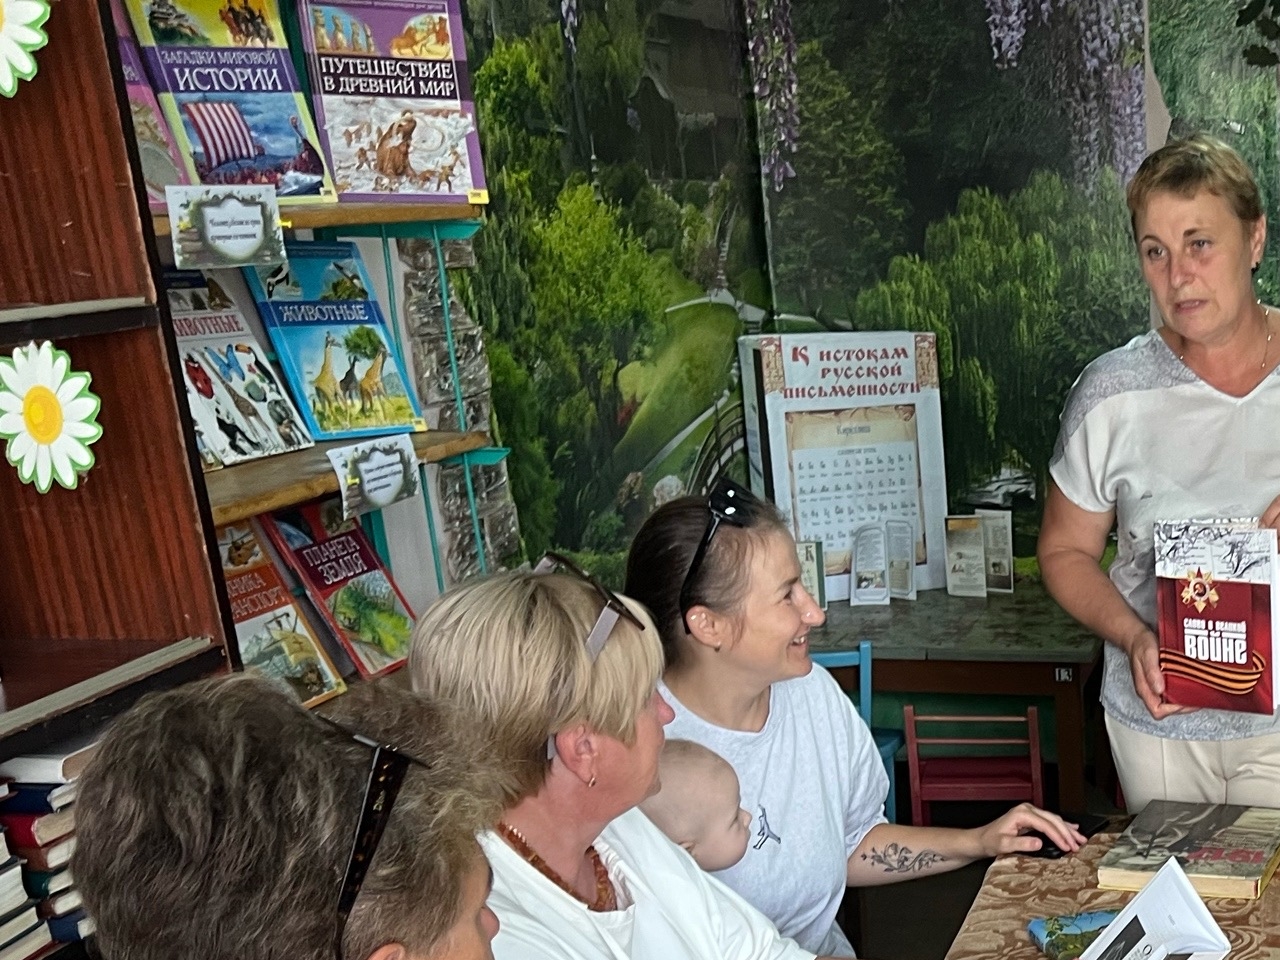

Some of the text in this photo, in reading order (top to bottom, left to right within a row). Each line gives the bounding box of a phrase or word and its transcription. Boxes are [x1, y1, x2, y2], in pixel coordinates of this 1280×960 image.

[161, 50, 278, 65] ЗАГАДКИ МИРОВОЙ
[320, 57, 453, 79] ПУТЕШЕСТВИЕ
[173, 67, 283, 91] ИСТОРИИ
[323, 76, 455, 96] В ДРЕВНИЙ МИР
[278, 303, 369, 322] ЖИВОТНЫЕ
[791, 346, 909, 366] К ИСТОКАМ
[821, 362, 903, 384] РУССКОЙ
[783, 382, 921, 400] ПИСЬМЕННОСТИ
[302, 535, 361, 568] ПЛАНЕТА
[317, 552, 368, 585] ЗЕМЛЯ
[231, 586, 286, 620] АНСПОРТ
[1183, 617, 1206, 630] СЛОВО
[1207, 619, 1214, 631] О
[1184, 630, 1247, 664] ВОЙНЕ
